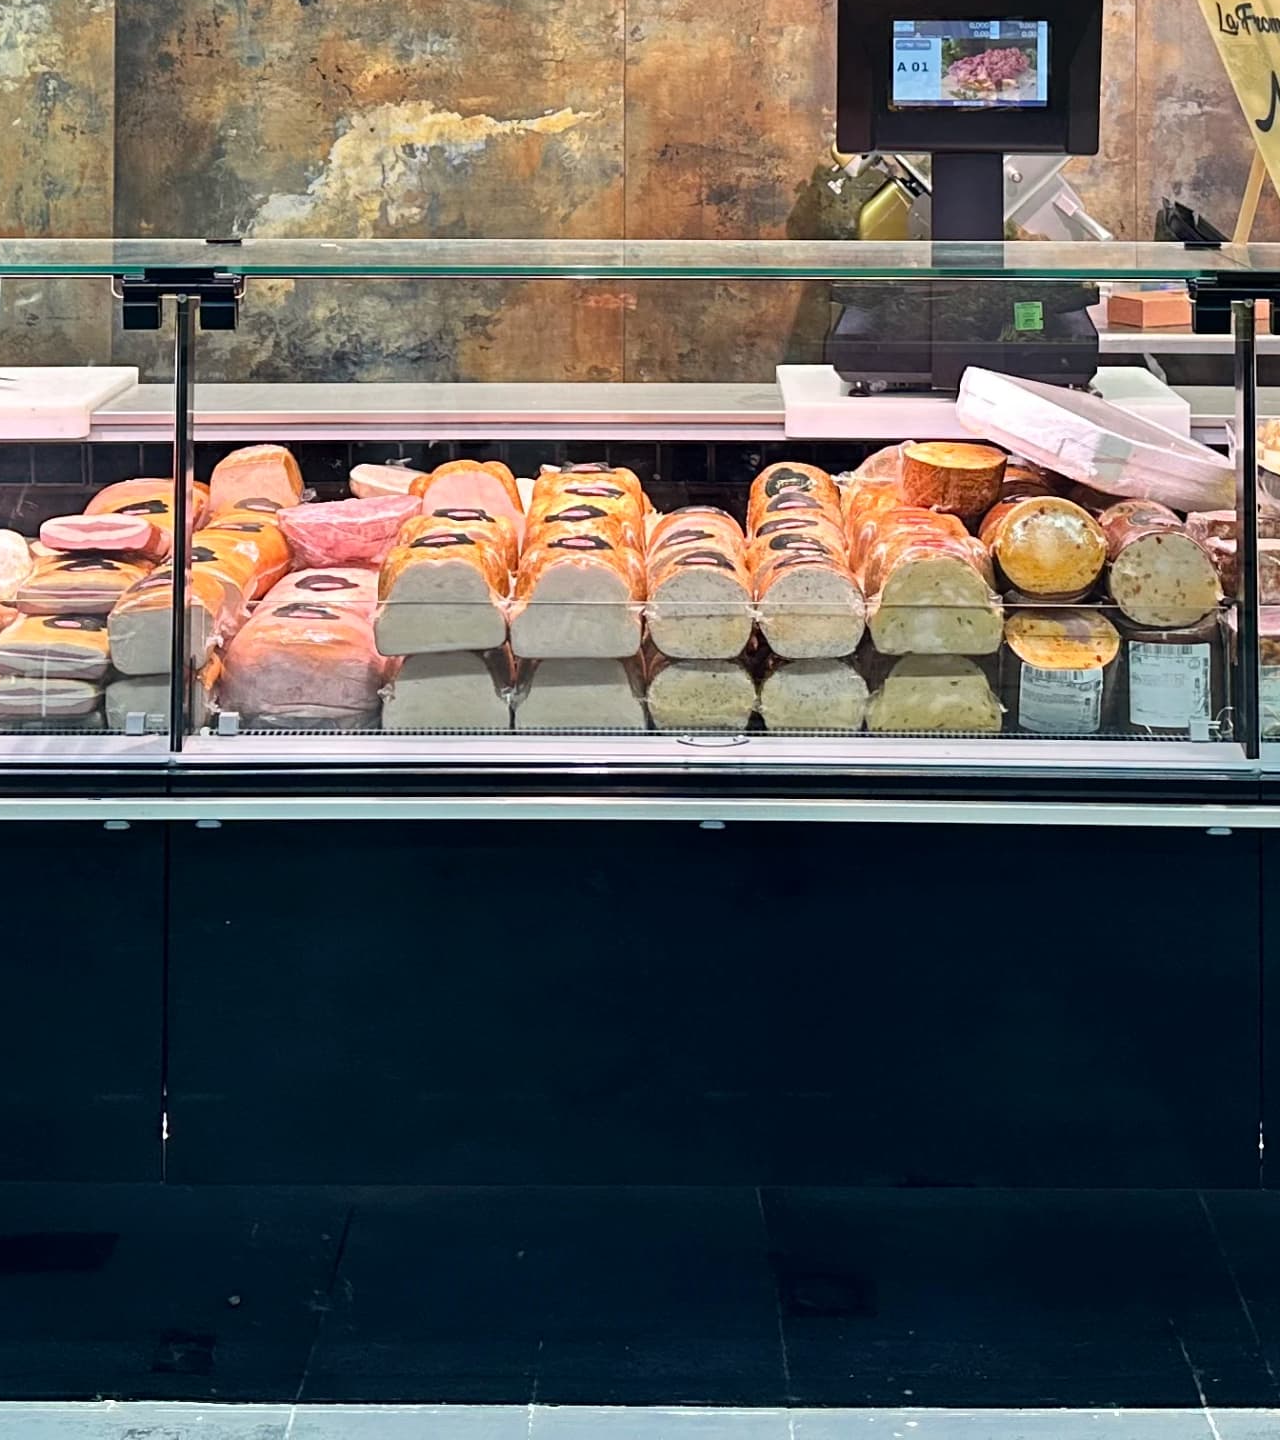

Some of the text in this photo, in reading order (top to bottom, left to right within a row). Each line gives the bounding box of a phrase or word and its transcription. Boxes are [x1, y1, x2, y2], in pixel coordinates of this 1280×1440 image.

[1216, 1, 1239, 36] La
[897, 61, 930, 73] A 01
